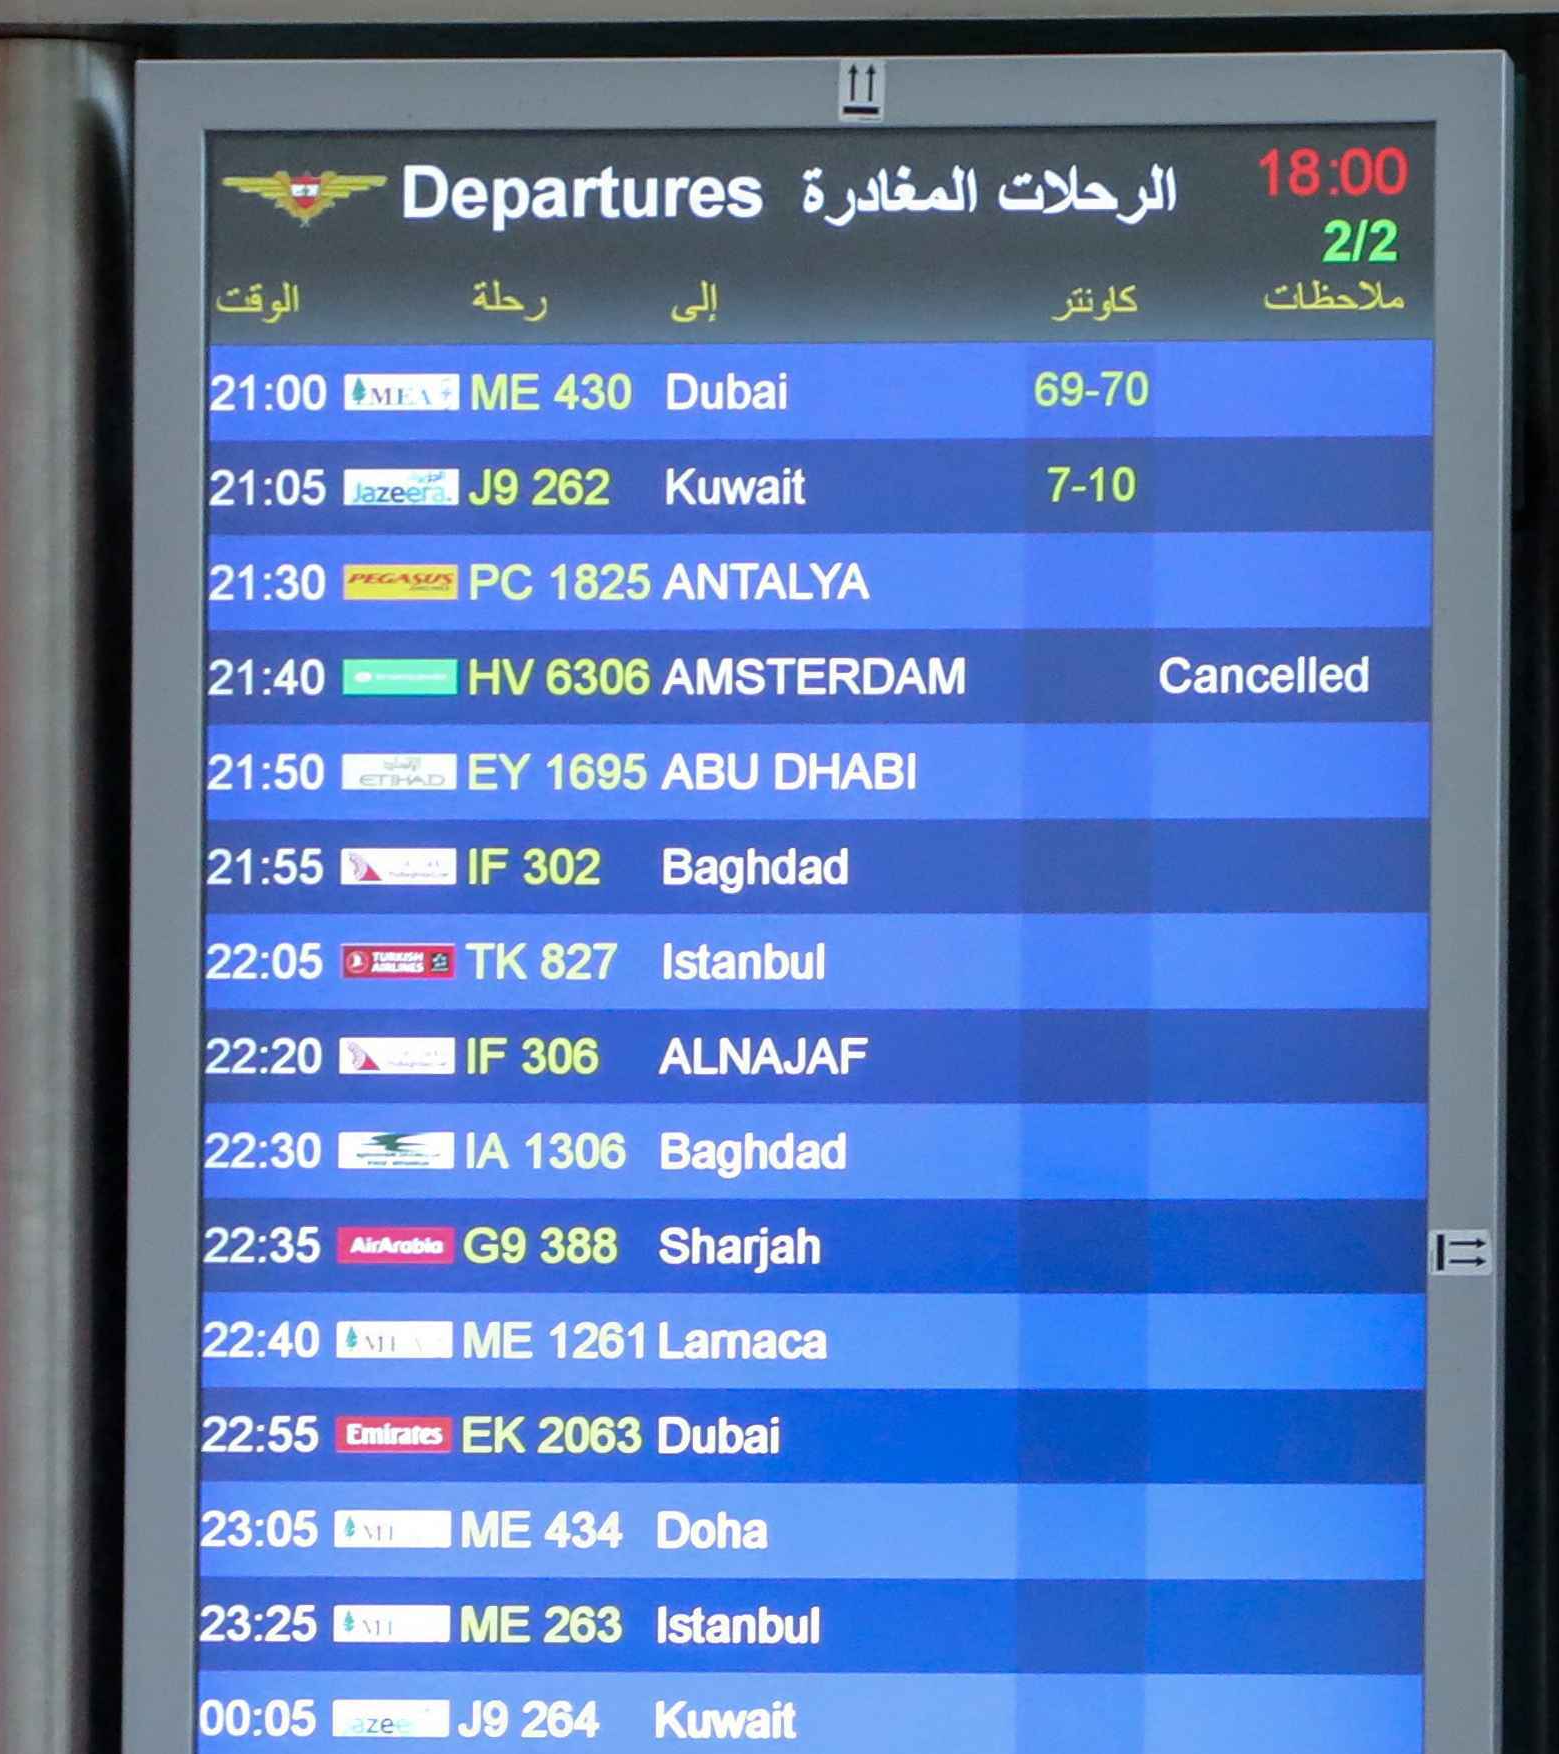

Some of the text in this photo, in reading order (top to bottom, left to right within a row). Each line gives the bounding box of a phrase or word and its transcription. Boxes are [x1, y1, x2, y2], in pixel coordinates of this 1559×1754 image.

[1259, 147, 1408, 196] 18:00
[403, 164, 763, 232] Departures
[802, 163, 1177, 227] الرحلات المغادرة
[1322, 219, 1397, 262] 2/2
[216, 282, 299, 324] الوقت
[472, 280, 547, 322] رحلة
[671, 280, 717, 323] إلى
[1052, 284, 1138, 322] كاونتر
[1264, 279, 1405, 311] ملاحظات
[209, 370, 1149, 411] 21:00 ME 430 Dubai 69-70
[209, 466, 1136, 506] 21:05 J9 262 Kuwait 7-10
[208, 562, 871, 601] 21:30 PC 1825 ANTALYA
[347, 572, 454, 585] PEGASUS
[208, 655, 1369, 696] 21:40 HV 6306 AMSTERDAM Cancelled
[207, 752, 916, 791] 21:50 EY 1695 ABU DHABI
[360, 774, 445, 786] ETIHAD
[206, 847, 324, 885] 21:55
[468, 847, 509, 885] IF
[523, 847, 601, 886] 302
[662, 847, 849, 894] Baghdad
[205, 1036, 322, 1075] 22:20
[467, 1037, 508, 1075] IF
[521, 1037, 599, 1075] 306
[658, 1037, 869, 1076] ALNAJAF
[203, 1226, 821, 1274] 22:35 G9 388 Sharjah
[200, 1415, 780, 1455] 22:55 EK 2063 Dubai
[346, 1423, 443, 1445] Emirates
